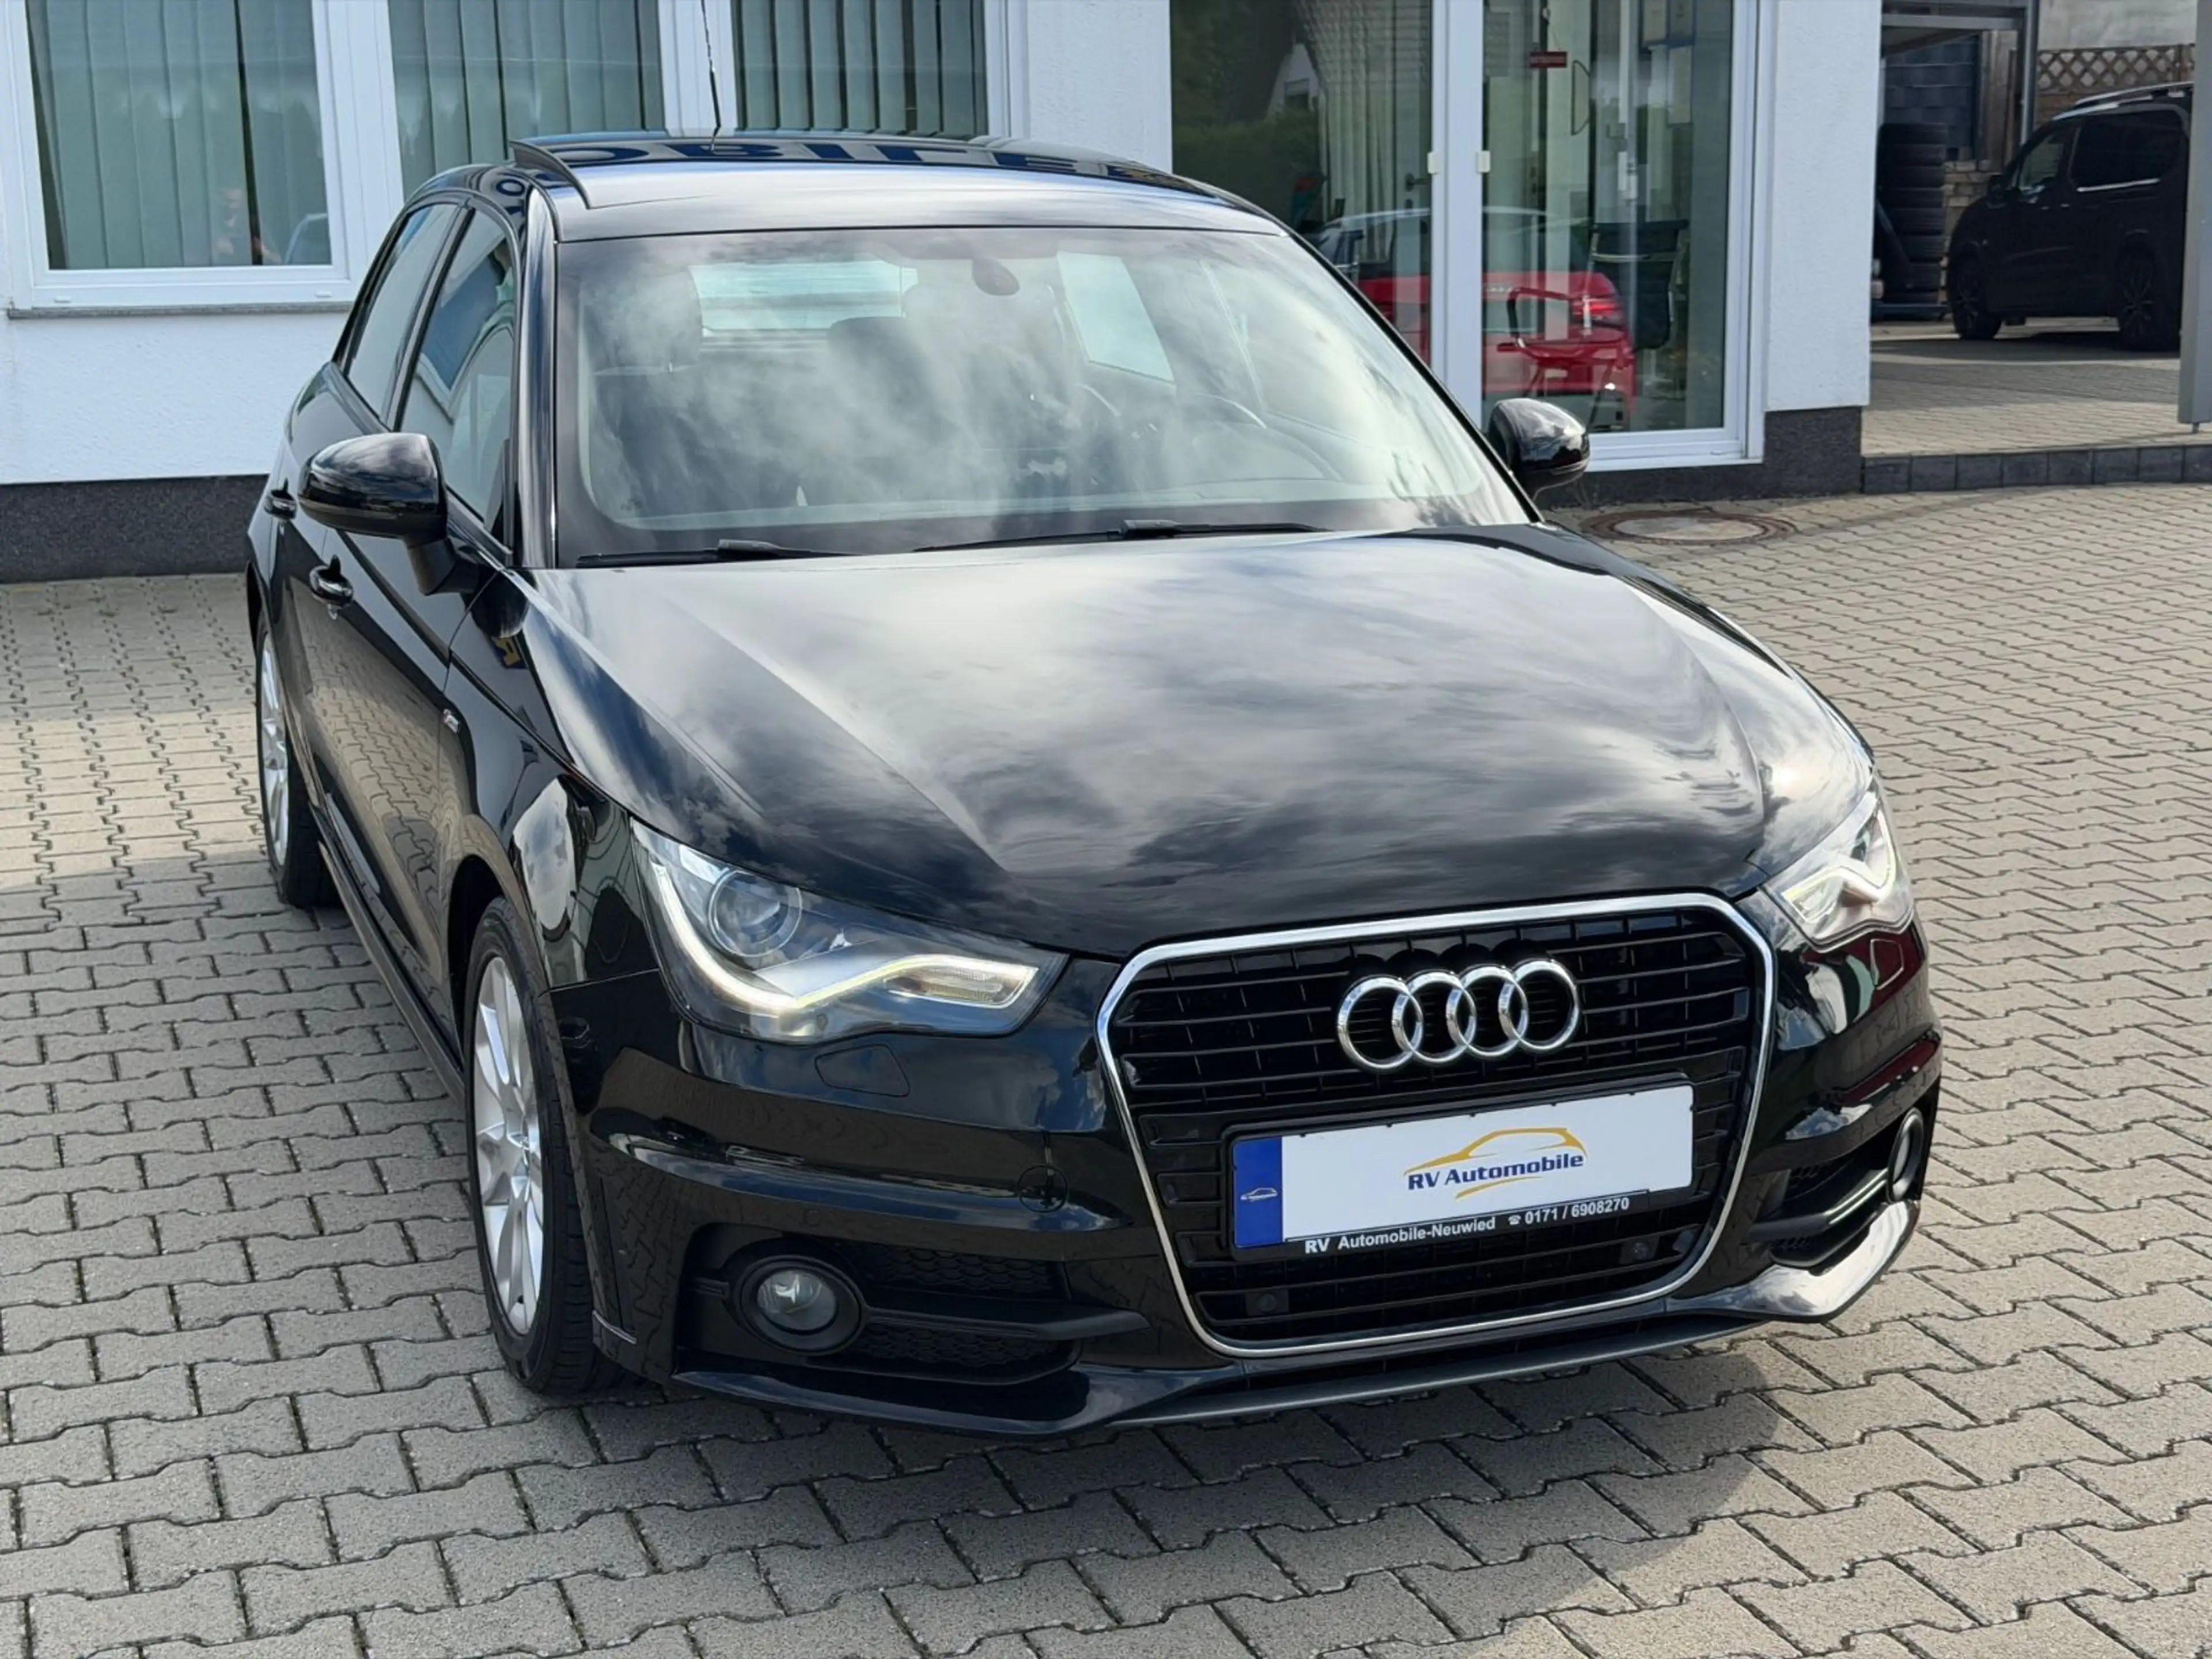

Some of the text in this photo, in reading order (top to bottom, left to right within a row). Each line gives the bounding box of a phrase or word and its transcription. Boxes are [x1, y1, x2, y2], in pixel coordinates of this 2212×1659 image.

[1408, 1153, 1584, 1190] RV Automobile
[1305, 1197, 1630, 1254] RV Automobile-Neuwied 0171 / 6908270
